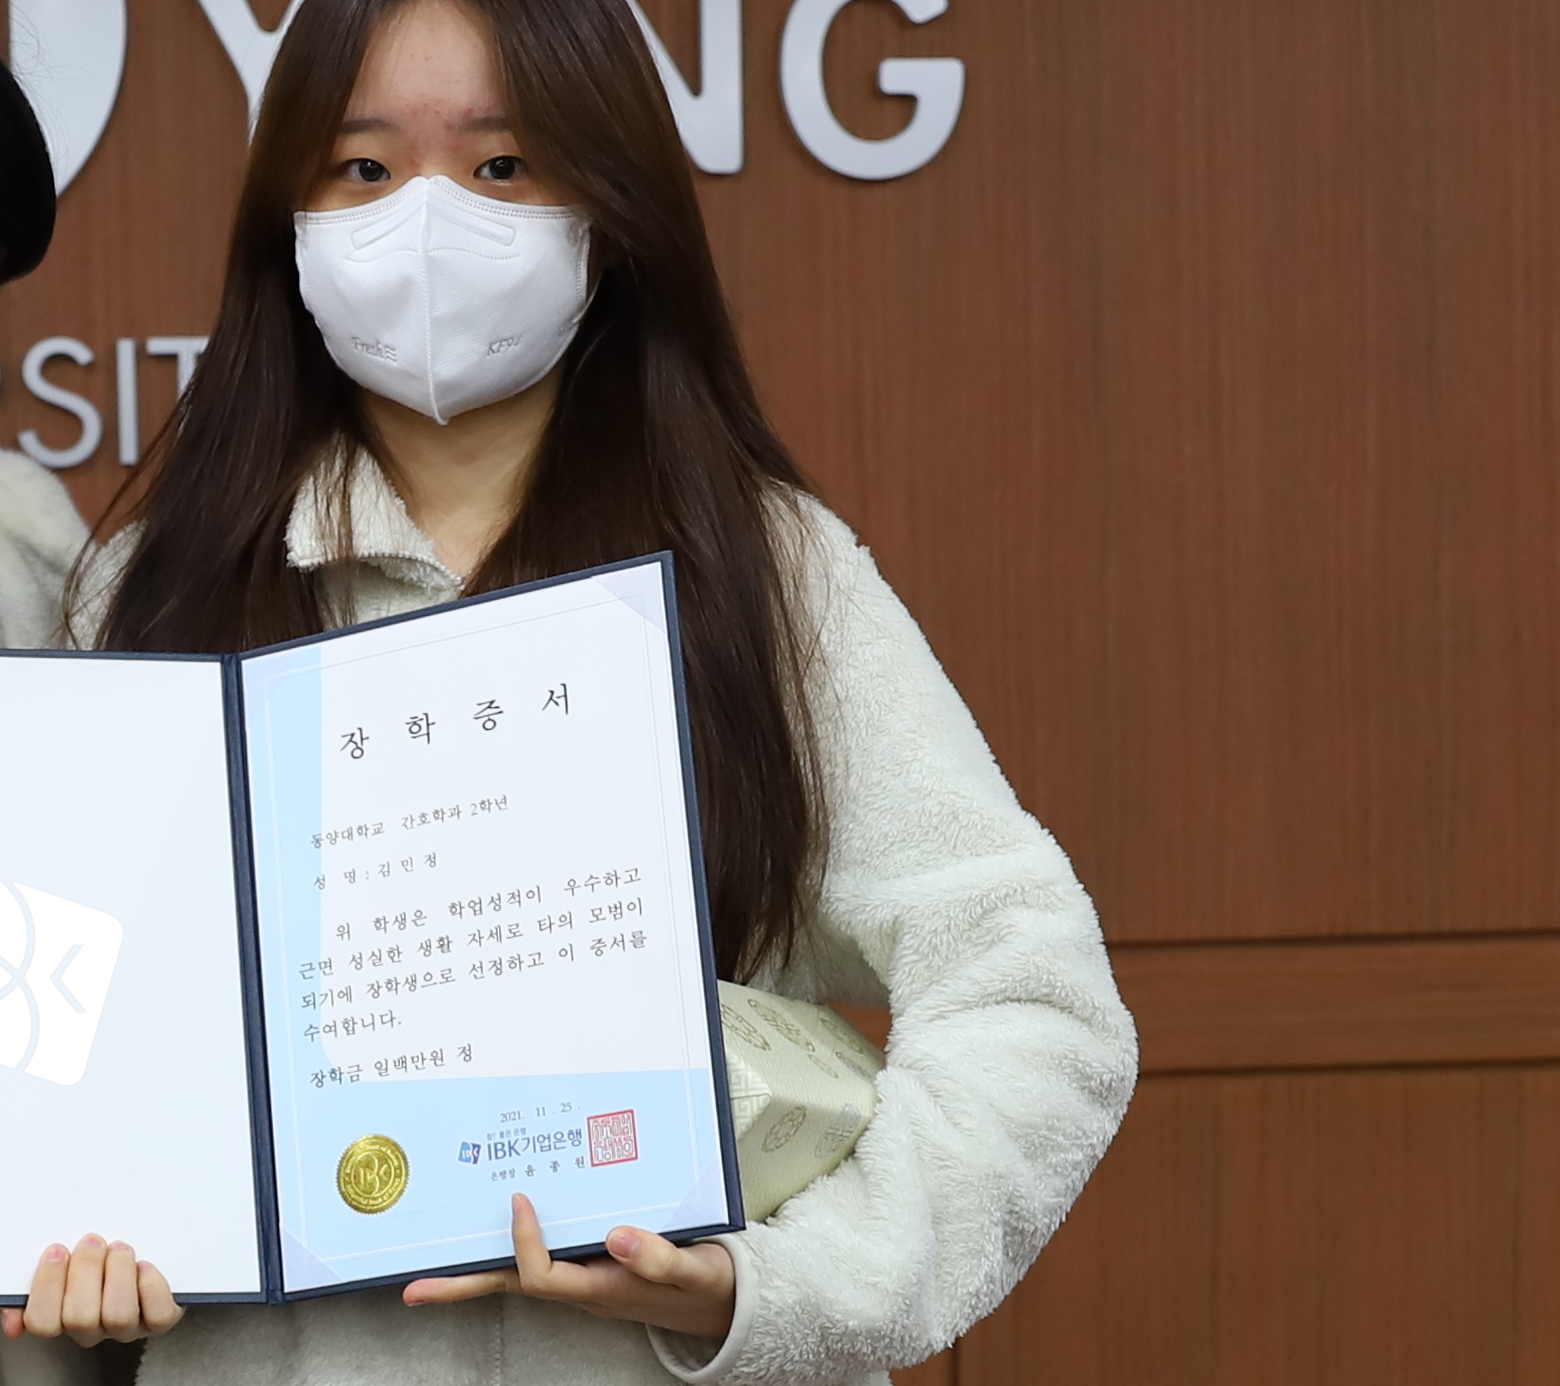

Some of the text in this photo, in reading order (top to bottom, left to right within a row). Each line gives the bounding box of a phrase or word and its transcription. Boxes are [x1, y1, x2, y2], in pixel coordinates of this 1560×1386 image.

[310, 795, 508, 849] 동양대학교 간호학과 2학년
[336, 867, 641, 941] 위 학생은 학업성적이 우수하고
[299, 897, 643, 980] 근면 성실한 생활 자세로 타의 모범이
[301, 930, 647, 1010] 되기에 장학생으로 선정하고 이 증서를
[303, 1009, 402, 1042] 수여합니다.
[310, 1043, 473, 1088] 장학금 일백만원 정
[487, 1128, 582, 1161] IBK기업은행
[490, 1168, 516, 1182] 은행장
